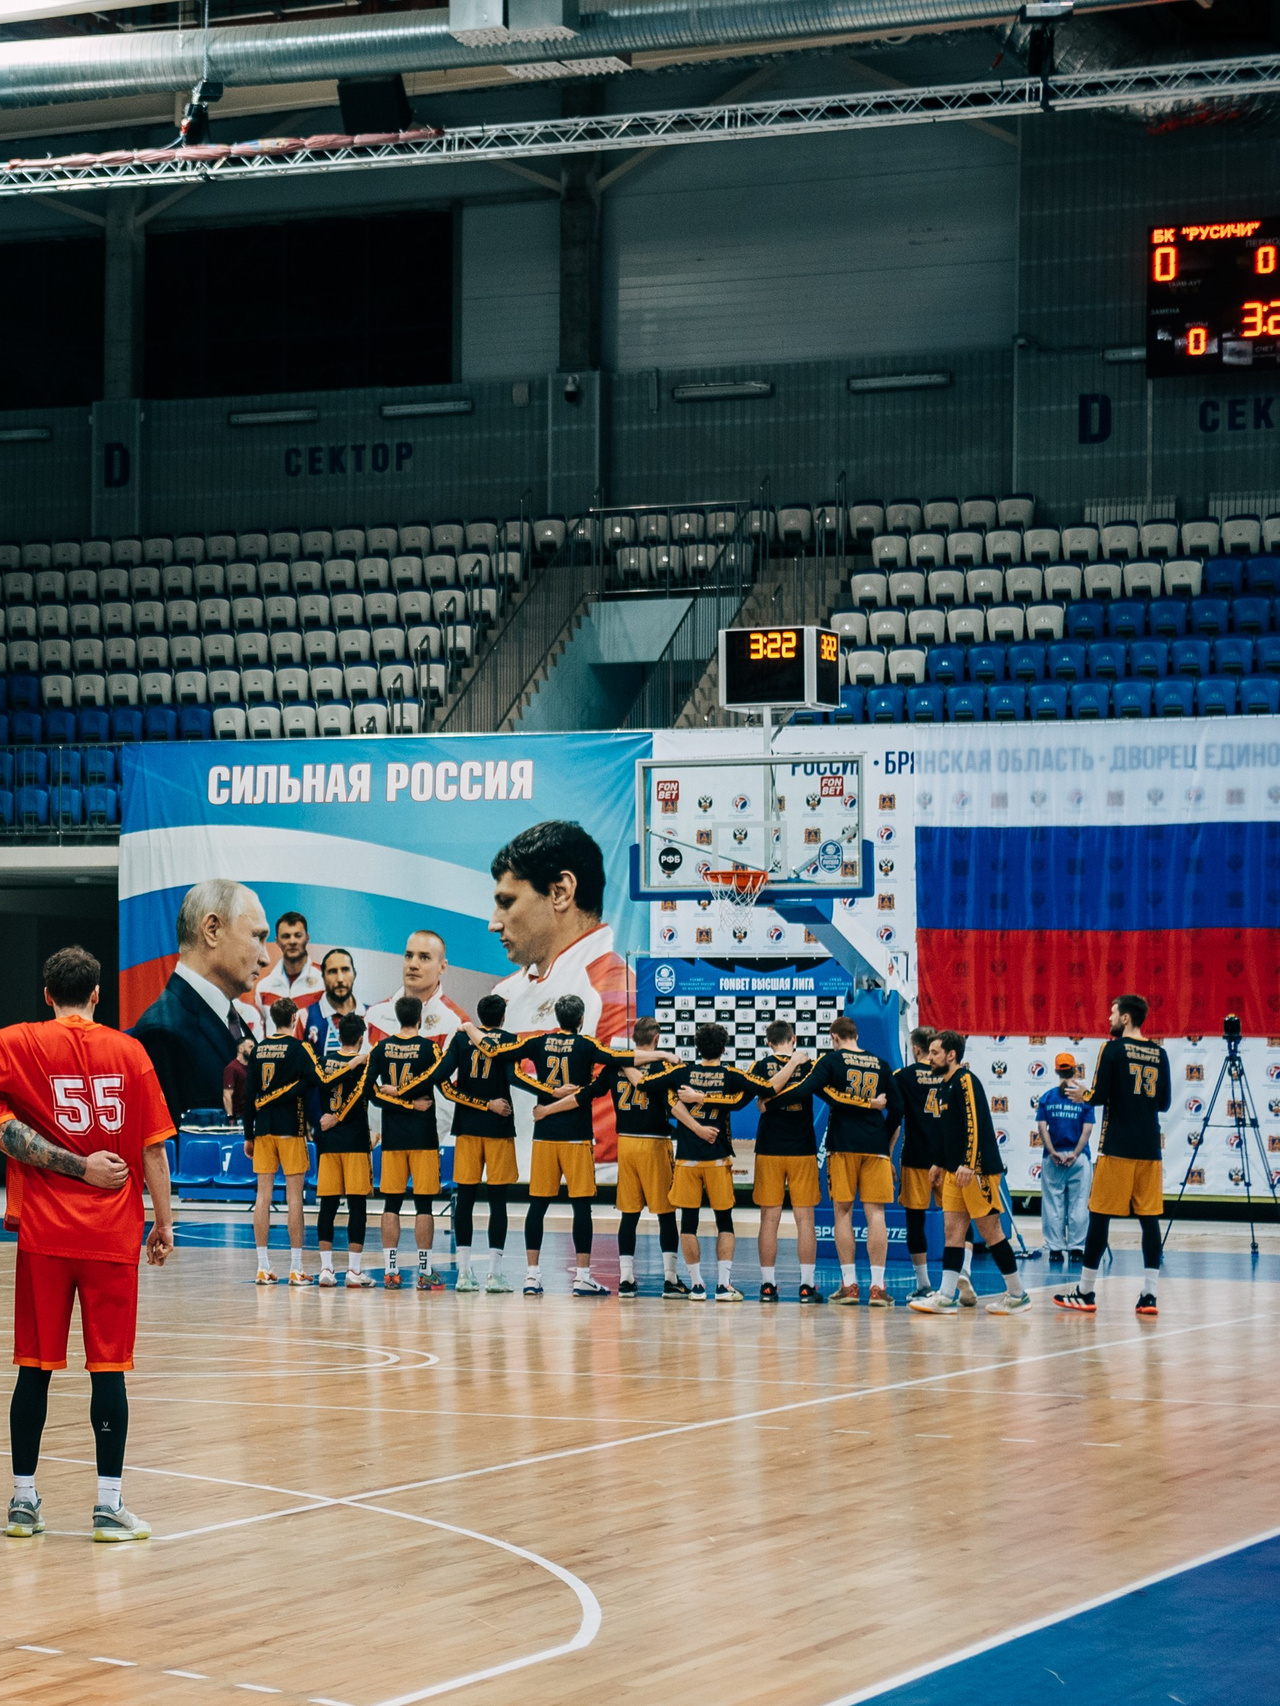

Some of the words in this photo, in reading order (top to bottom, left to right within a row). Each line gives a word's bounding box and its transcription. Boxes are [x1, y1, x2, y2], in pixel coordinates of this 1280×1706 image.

[1152, 228, 1175, 243] БК
[1153, 246, 1177, 282] 0
[1256, 245, 1276, 275] 0
[1187, 327, 1207, 356] 0
[1078, 394, 1112, 444] D
[104, 442, 130, 488] D
[285, 442, 413, 477] СЕКТОР
[749, 631, 797, 660] 3:22
[884, 750, 991, 775] БРЯНСКАЯ
[997, 747, 1095, 775] ОБЛАСТЬ
[1109, 744, 1198, 773] ДВОРЕЦ
[207, 763, 371, 806] СИЛЬНАЯ
[385, 759, 534, 803] РОССИЯ
[657, 782, 678, 791] FON
[657, 790, 679, 800] BET
[821, 785, 842, 796] BET
[822, 777, 842, 787] FON
[660, 855, 681, 864] РФБ
[719, 977, 750, 991] FONBET
[751, 977, 791, 991] ВЫСШАЯ
[792, 977, 815, 991] ЛИГА
[546, 1056, 570, 1087] 21
[845, 1069, 879, 1098] 38
[1129, 1063, 1158, 1098] 73
[49, 1073, 125, 1136] 55
[617, 1081, 650, 1110] 24
